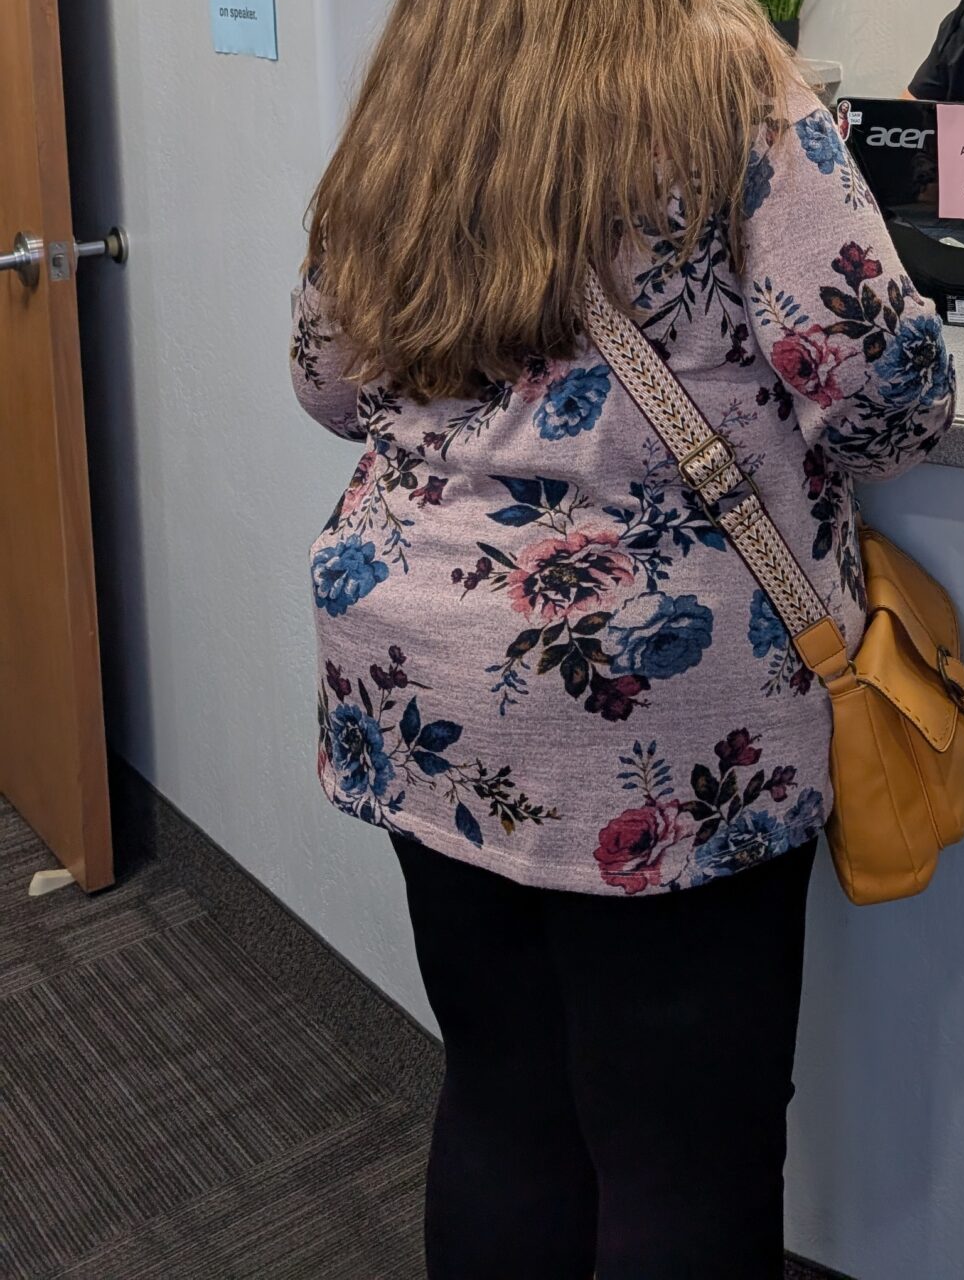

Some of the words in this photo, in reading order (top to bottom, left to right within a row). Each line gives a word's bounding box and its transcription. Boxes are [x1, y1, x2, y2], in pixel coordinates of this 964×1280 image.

[220, 7, 228, 17] on
[230, 7, 257, 20] speaker.
[866, 126, 935, 149] acer
